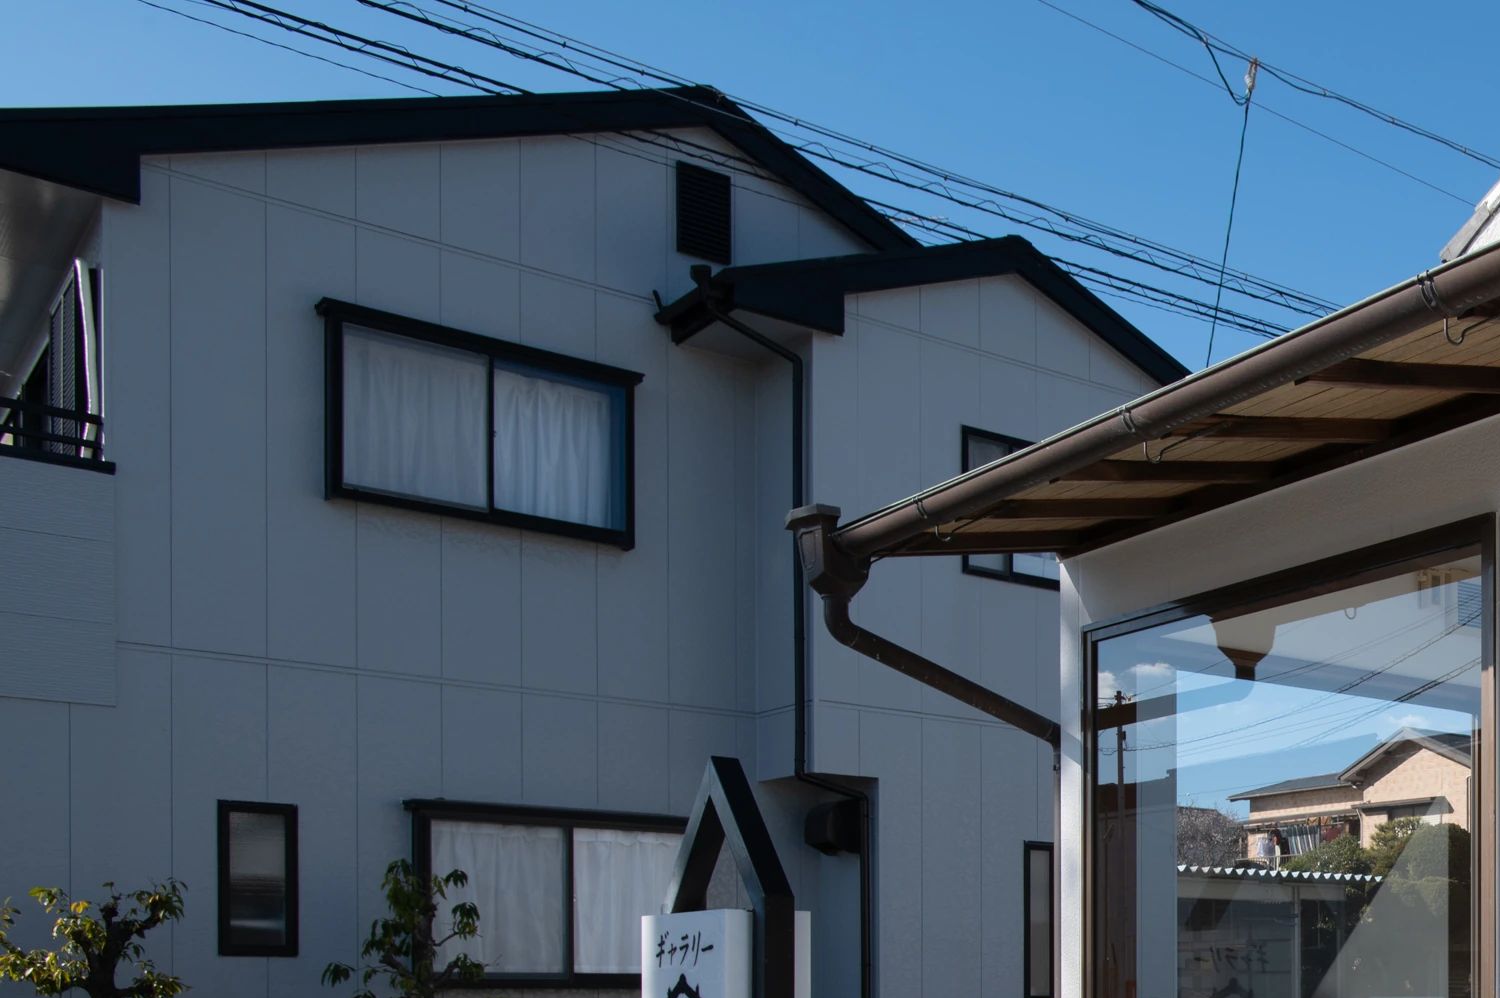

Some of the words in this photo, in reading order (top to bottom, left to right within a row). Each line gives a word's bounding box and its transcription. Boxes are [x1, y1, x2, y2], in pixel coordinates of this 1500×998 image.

[656, 930, 714, 968] ギャラリー
